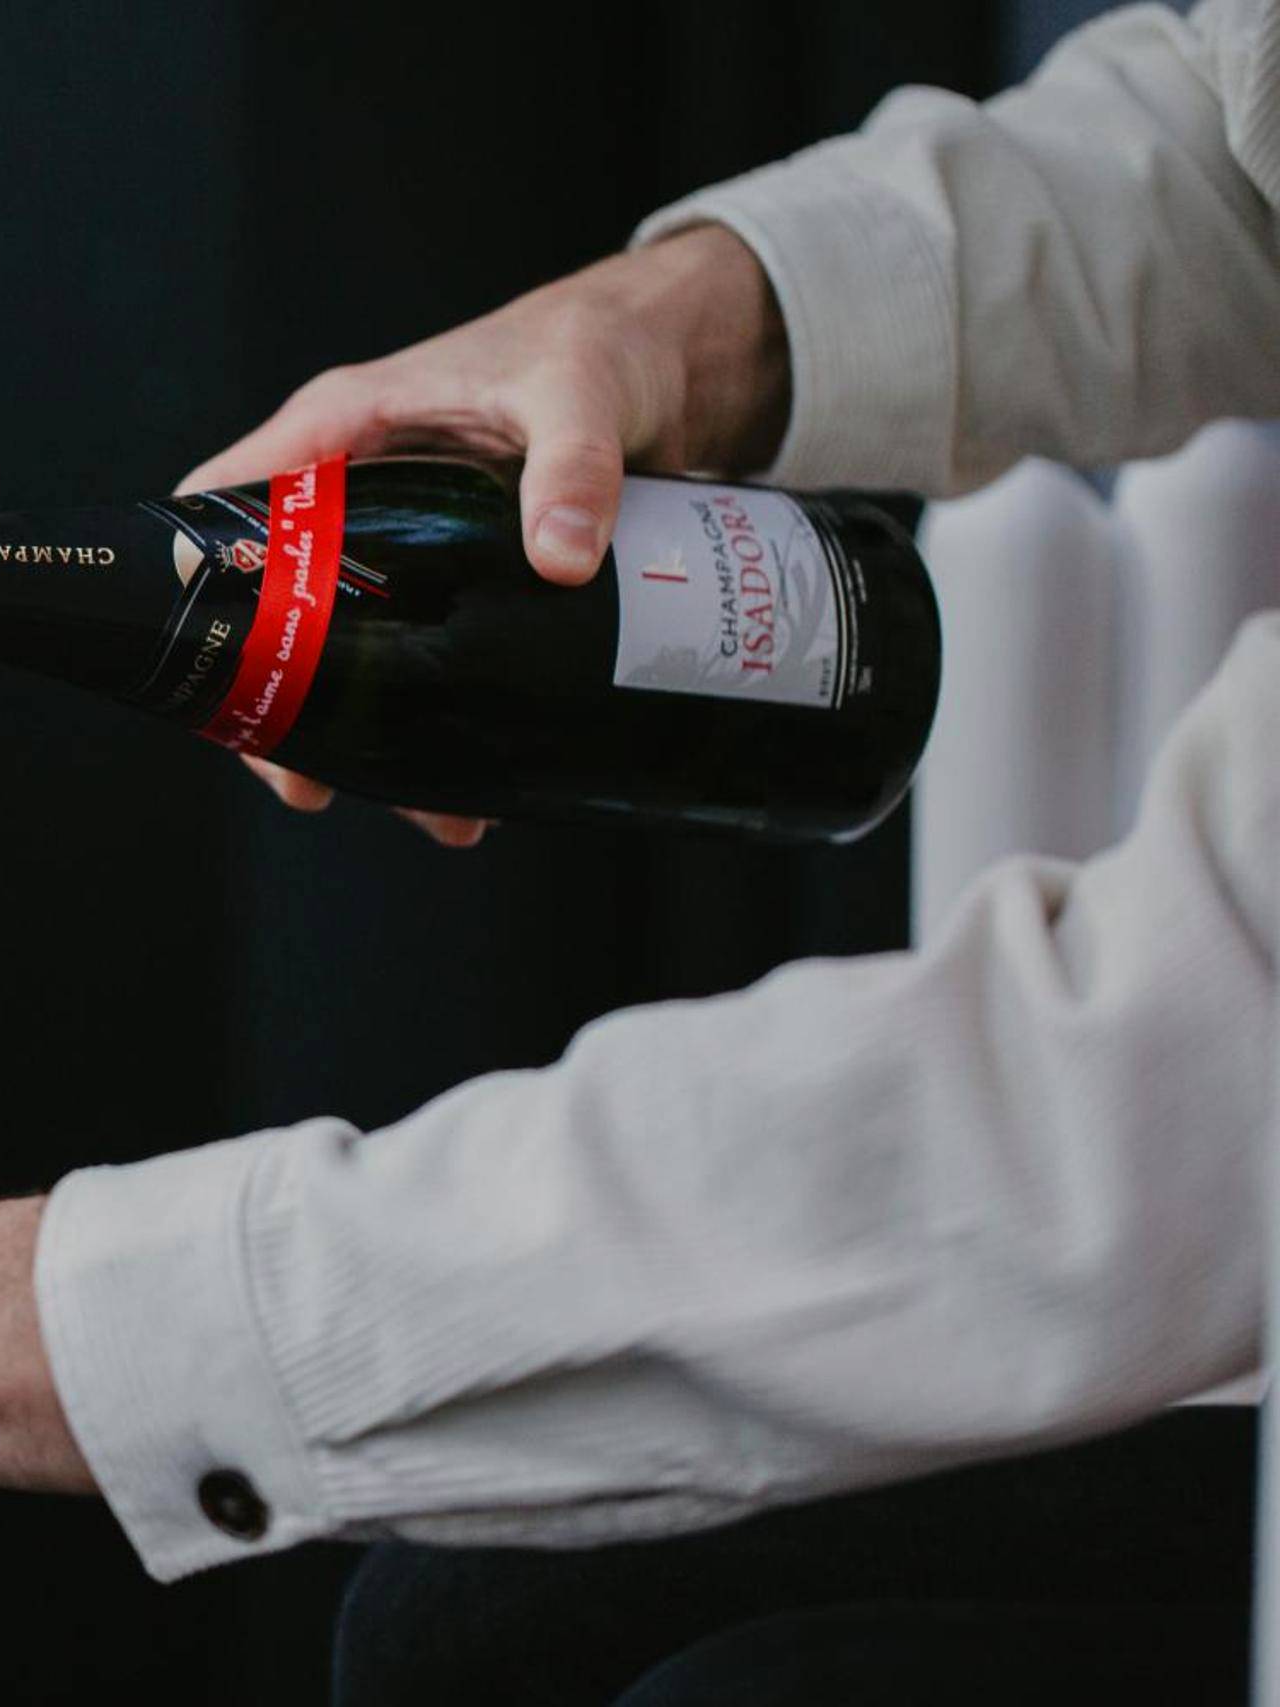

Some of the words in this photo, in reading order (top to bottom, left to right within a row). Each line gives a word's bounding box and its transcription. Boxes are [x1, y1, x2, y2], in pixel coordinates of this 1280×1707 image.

[276, 606, 302, 662] sans
[688, 499, 738, 659] CHAMPAGNE
[713, 495, 775, 677] ISADORA
